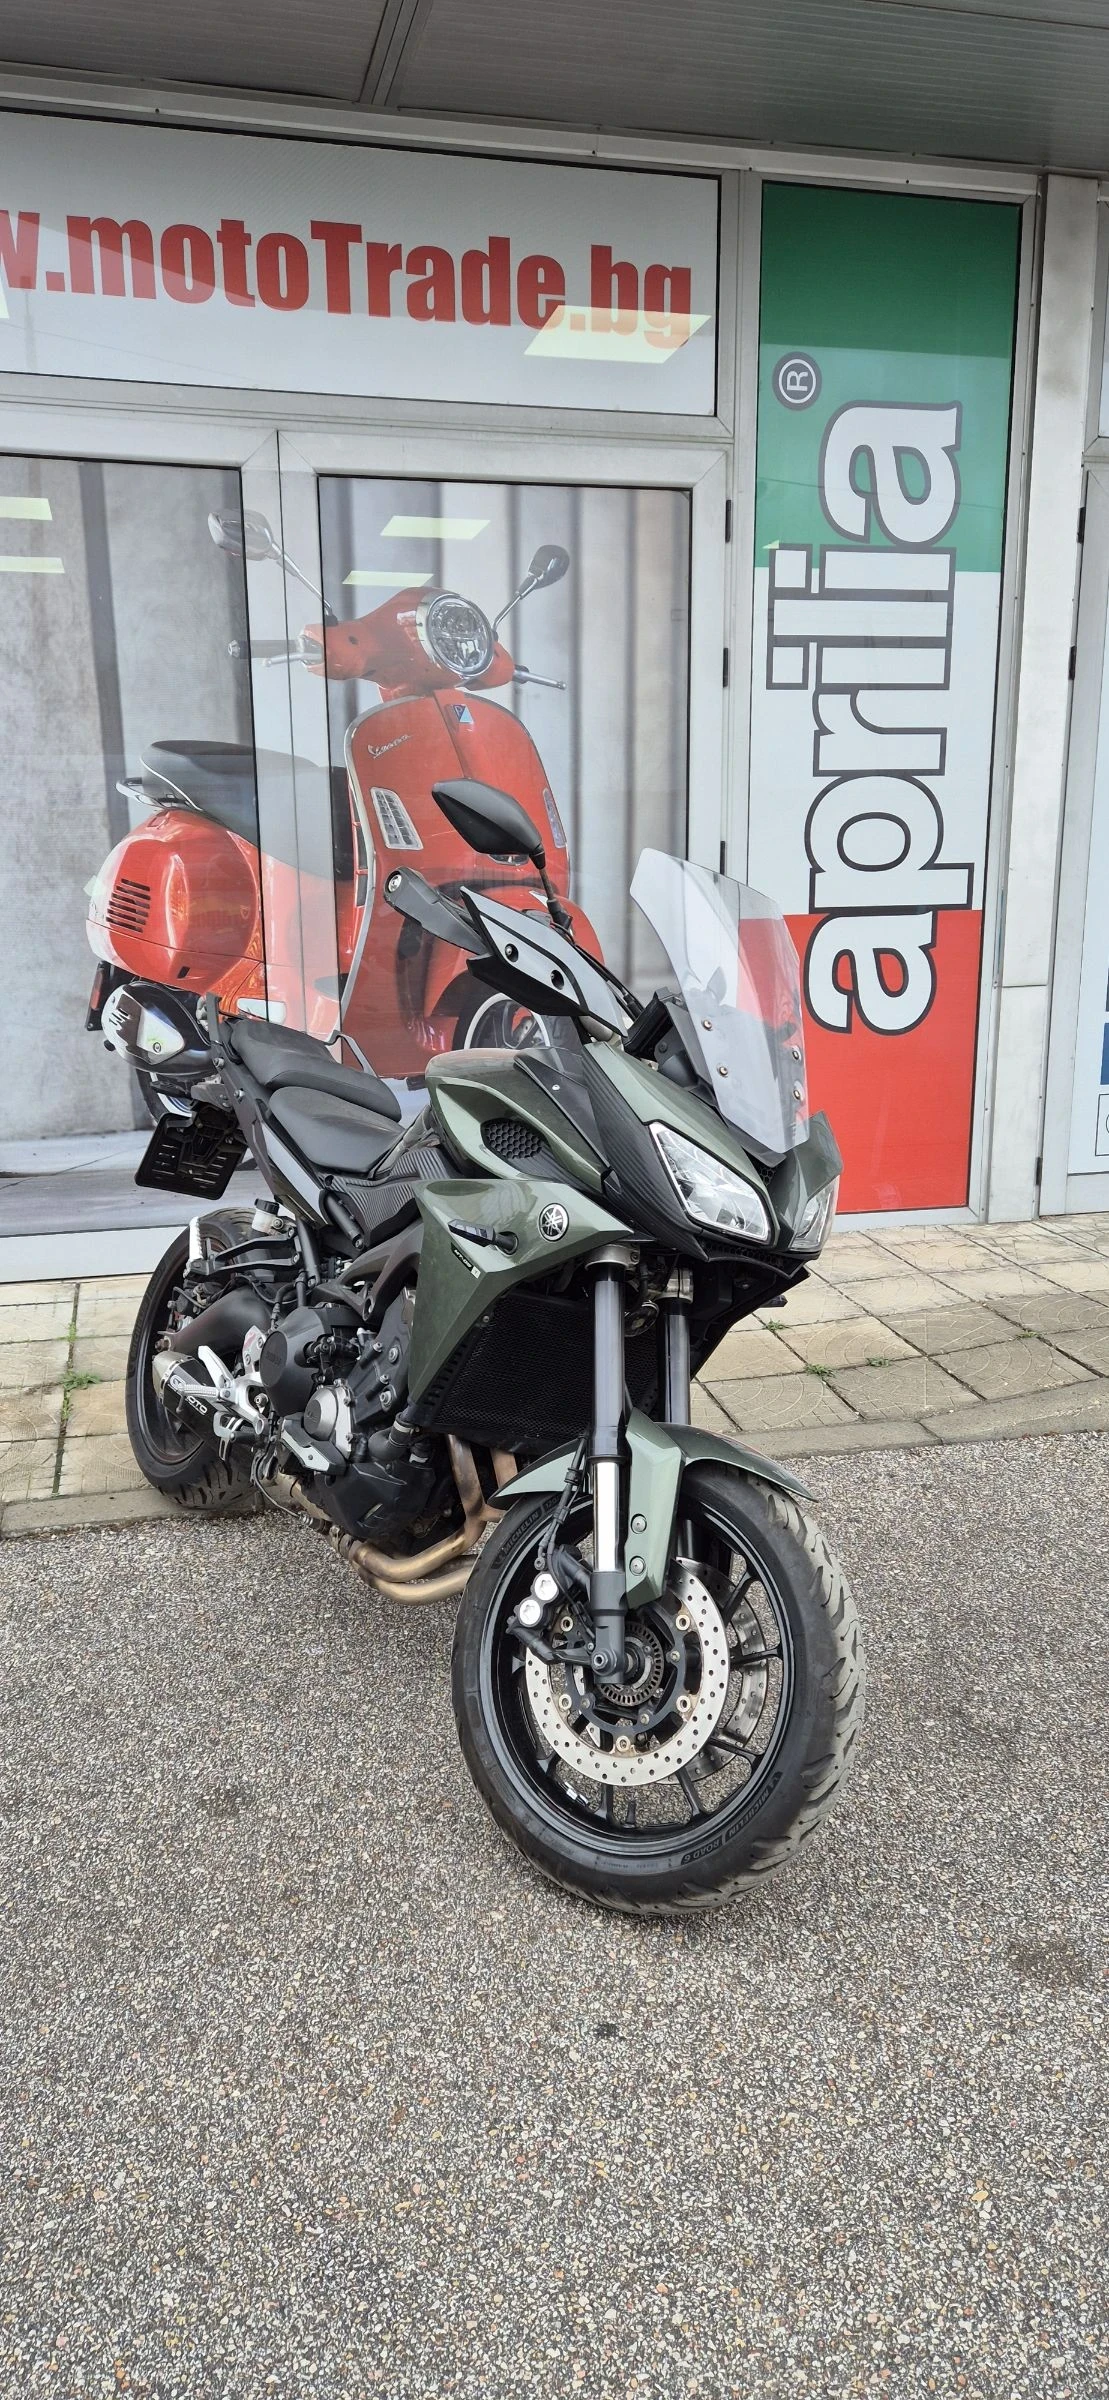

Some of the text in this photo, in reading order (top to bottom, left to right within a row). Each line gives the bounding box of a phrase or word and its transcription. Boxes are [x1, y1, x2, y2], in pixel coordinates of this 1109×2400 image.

[766, 400, 974, 1036] aprilia
[504, 1511, 539, 1554] MICHELIN
[728, 1787, 771, 1837] MICHELIN
[693, 1838, 720, 1859] ROAD
